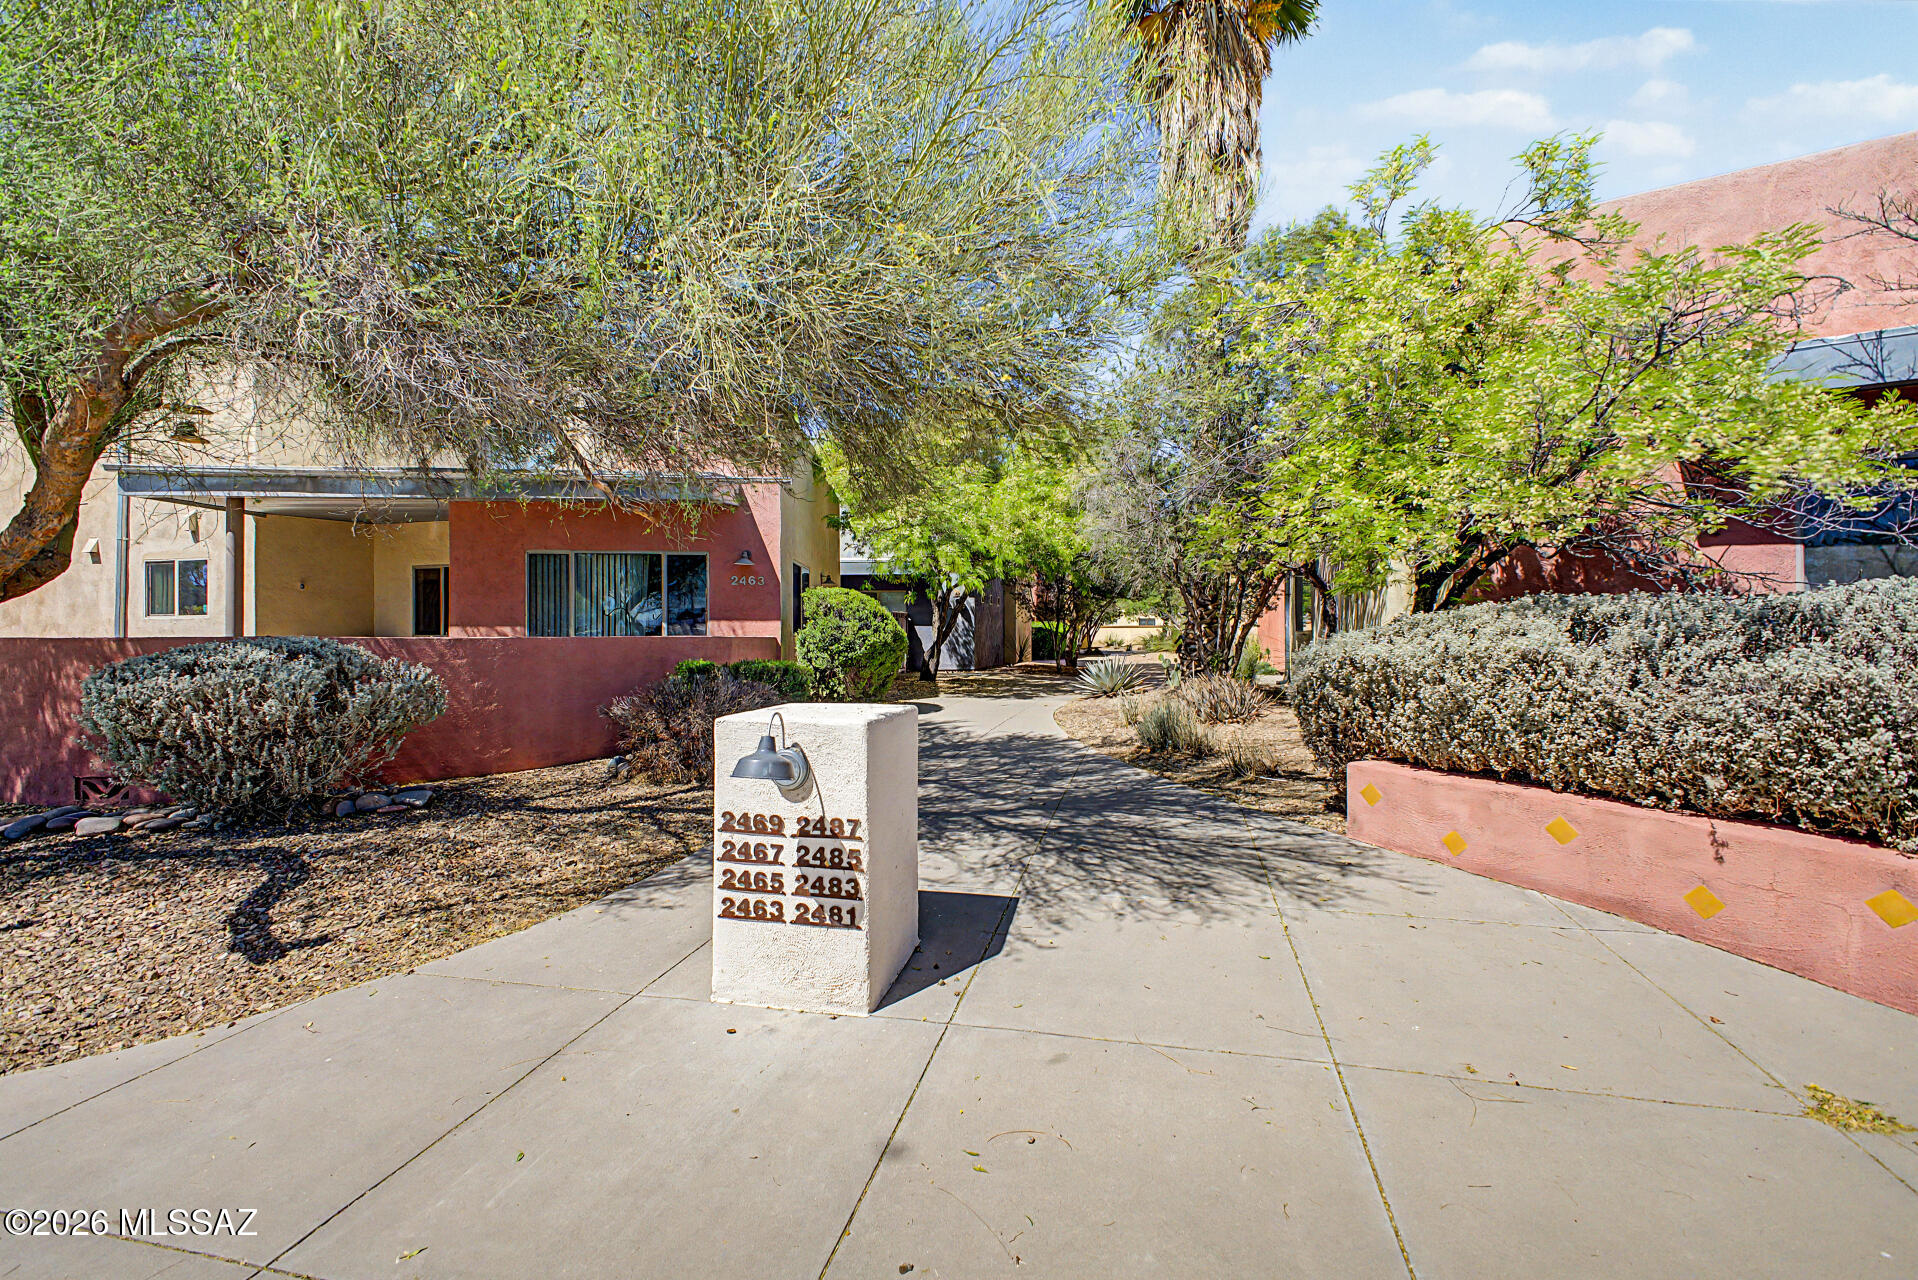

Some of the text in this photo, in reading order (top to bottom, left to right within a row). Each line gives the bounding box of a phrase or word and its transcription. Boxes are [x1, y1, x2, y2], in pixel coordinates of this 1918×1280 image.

[730, 575, 765, 586] 2463
[721, 811, 786, 834] 2469
[796, 816, 862, 837] 2487
[721, 840, 785, 864] 2467
[796, 845, 862, 869] 2485
[721, 868, 785, 892] 2465
[795, 874, 860, 898] 2483
[721, 897, 784, 921] 2463
[795, 902, 857, 927] 2481
